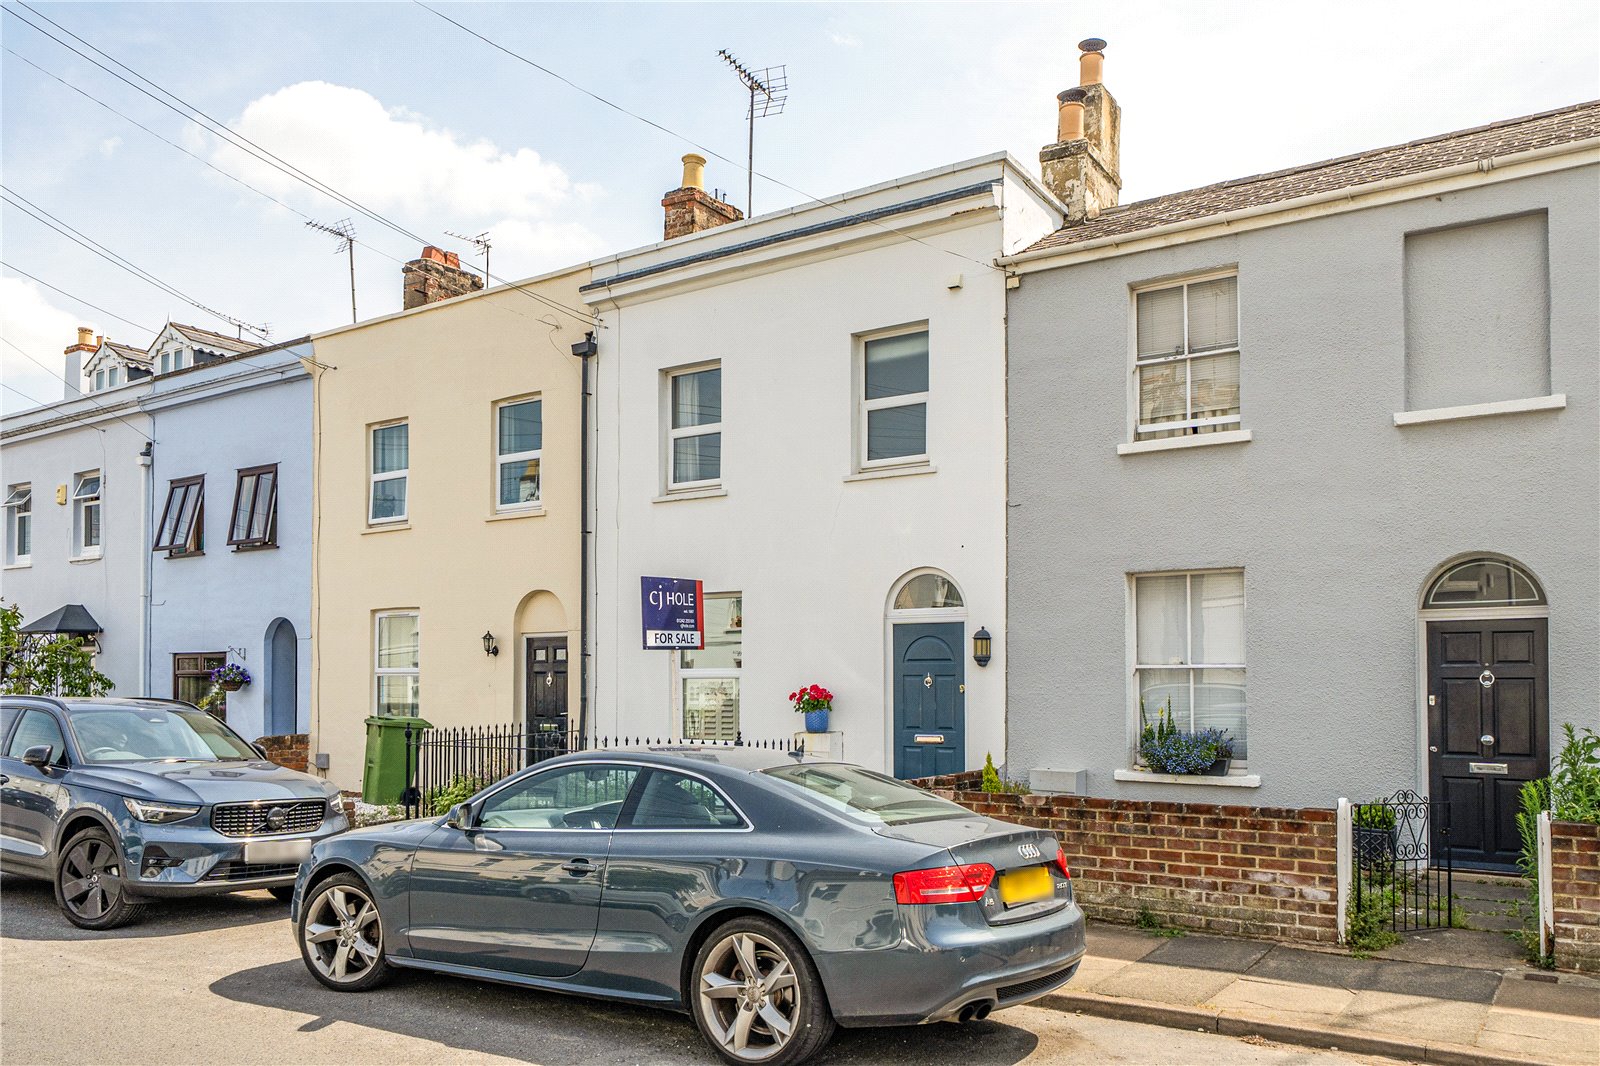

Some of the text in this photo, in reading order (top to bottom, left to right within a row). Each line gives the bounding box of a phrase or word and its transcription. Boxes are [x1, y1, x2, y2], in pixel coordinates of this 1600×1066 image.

[650, 585, 694, 610] cj HOLE
[654, 633, 694, 644] FOR SALE
